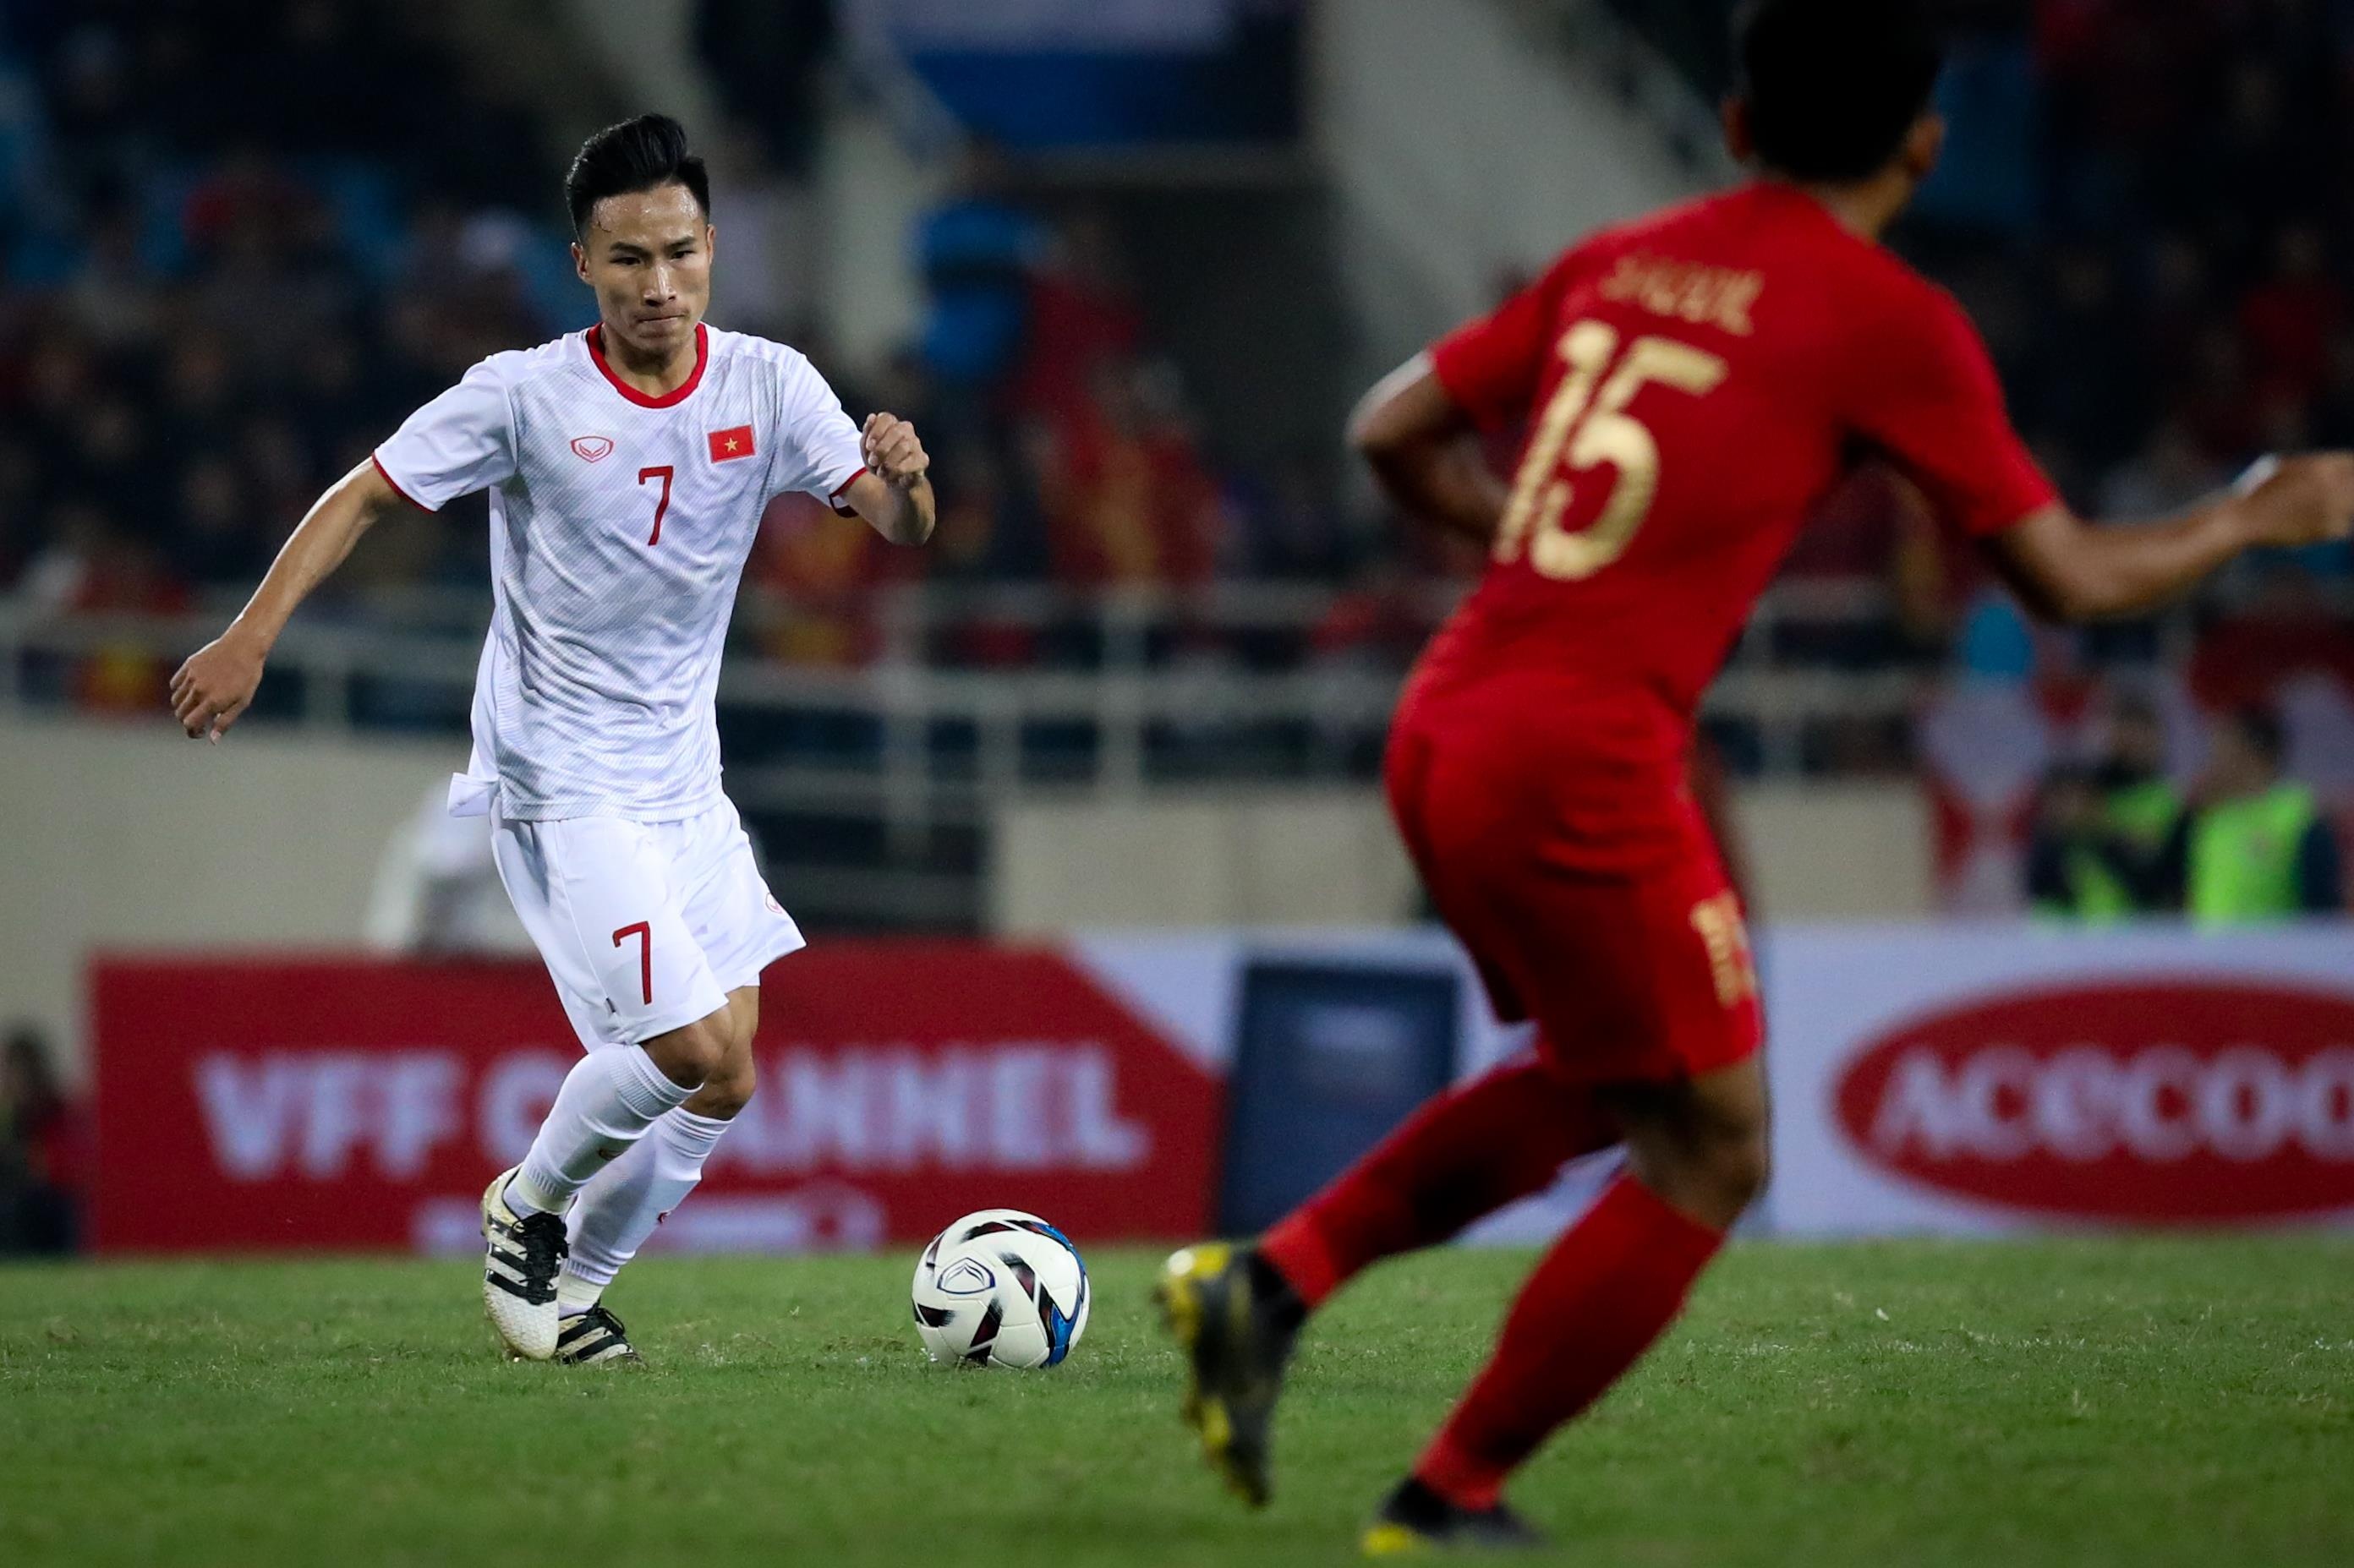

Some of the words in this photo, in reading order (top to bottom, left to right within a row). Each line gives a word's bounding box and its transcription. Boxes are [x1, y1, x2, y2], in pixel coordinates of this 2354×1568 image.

[1494, 318, 1729, 581] 15
[638, 465, 674, 546] 7
[612, 921, 652, 1005] 7
[194, 1048, 463, 1177] VFF
